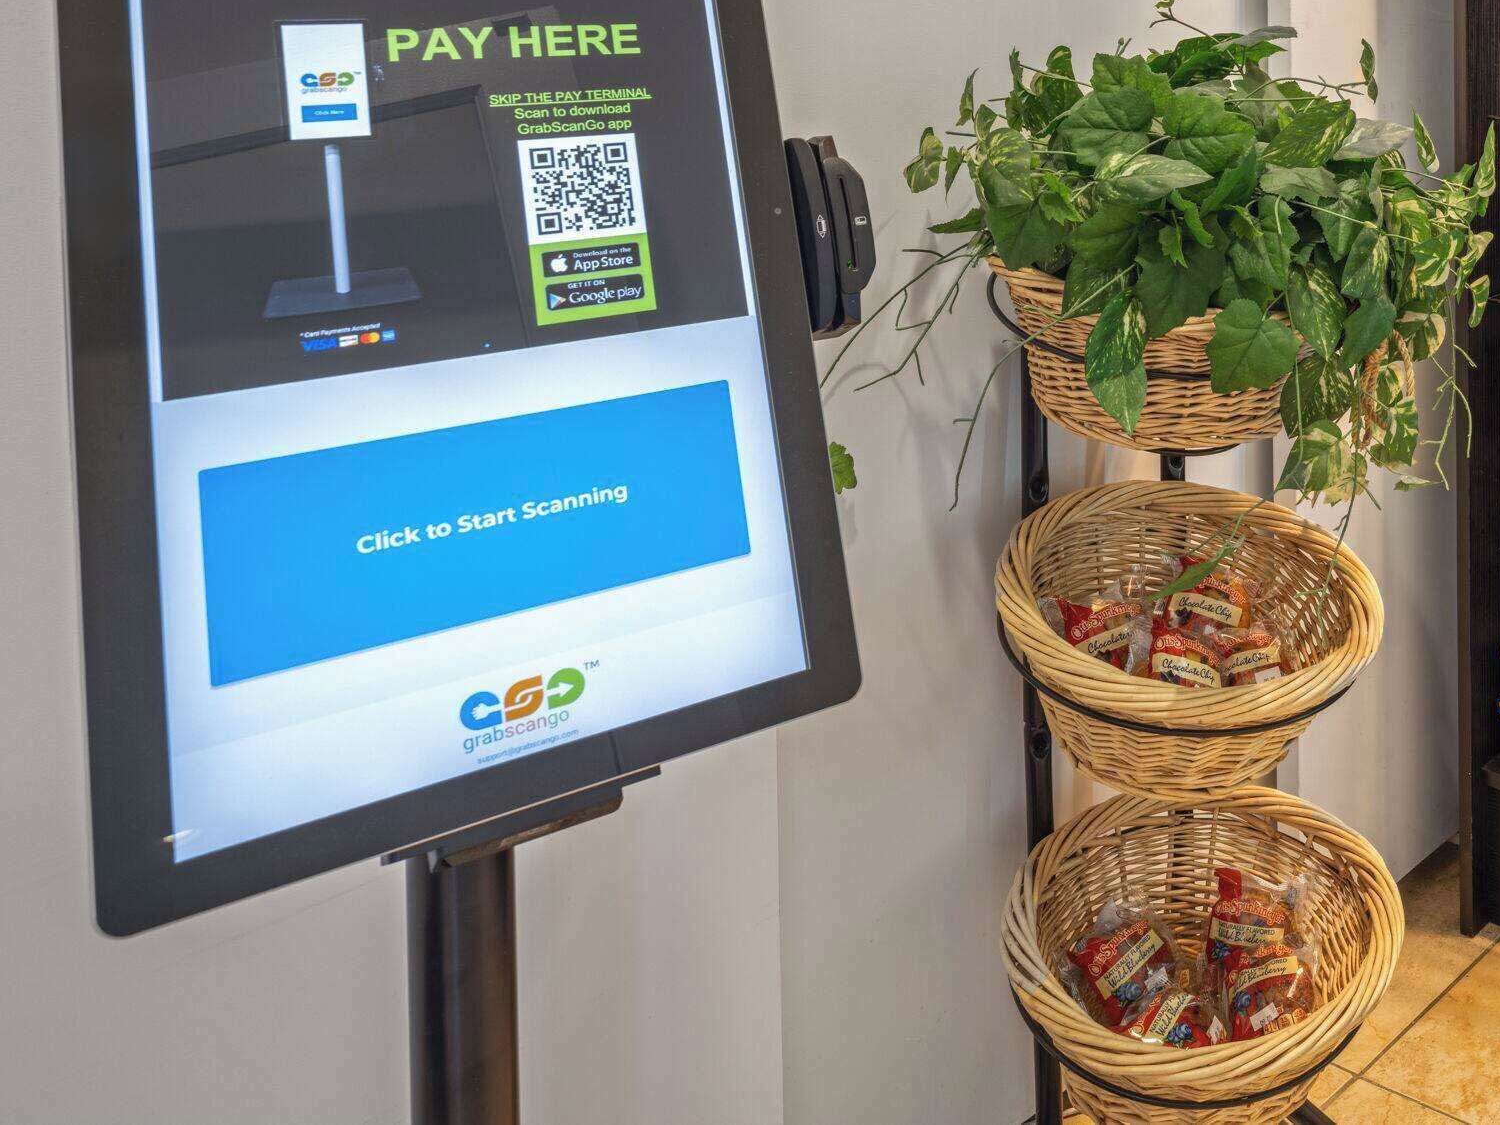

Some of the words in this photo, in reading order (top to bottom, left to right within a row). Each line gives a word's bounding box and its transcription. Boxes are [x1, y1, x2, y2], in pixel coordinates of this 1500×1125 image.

[385, 26, 494, 63] PAY
[508, 22, 642, 58] HERE
[489, 93, 521, 106] SKIP
[526, 92, 553, 104] THE
[556, 90, 583, 103] PAY
[584, 87, 652, 101] TERMINAL
[514, 107, 550, 120] Scan
[552, 106, 567, 118] to
[569, 102, 632, 117] download
[517, 118, 605, 135] GrabScanGo
[607, 119, 633, 132] app
[573, 248, 608, 259] Download
[619, 246, 632, 254] the
[574, 259, 600, 272] App
[600, 255, 634, 266] Store
[568, 280, 583, 289] GET
[592, 278, 606, 286] ON
[569, 287, 616, 304] Google
[617, 285, 642, 300] play
[355, 526, 421, 555] Click
[425, 521, 452, 540] to
[457, 506, 517, 534] Start
[521, 484, 629, 520] Scanning
[1178, 596, 1216, 615] Chocolate
[1213, 604, 1232, 622] Chip
[1162, 657, 1201, 678] Chocolate
[1200, 667, 1215, 685] Chip
[462, 709, 570, 755] grabscango
[476, 728, 580, 766] support@grabscango.com
[1245, 926, 1276, 936] FLAVORED
